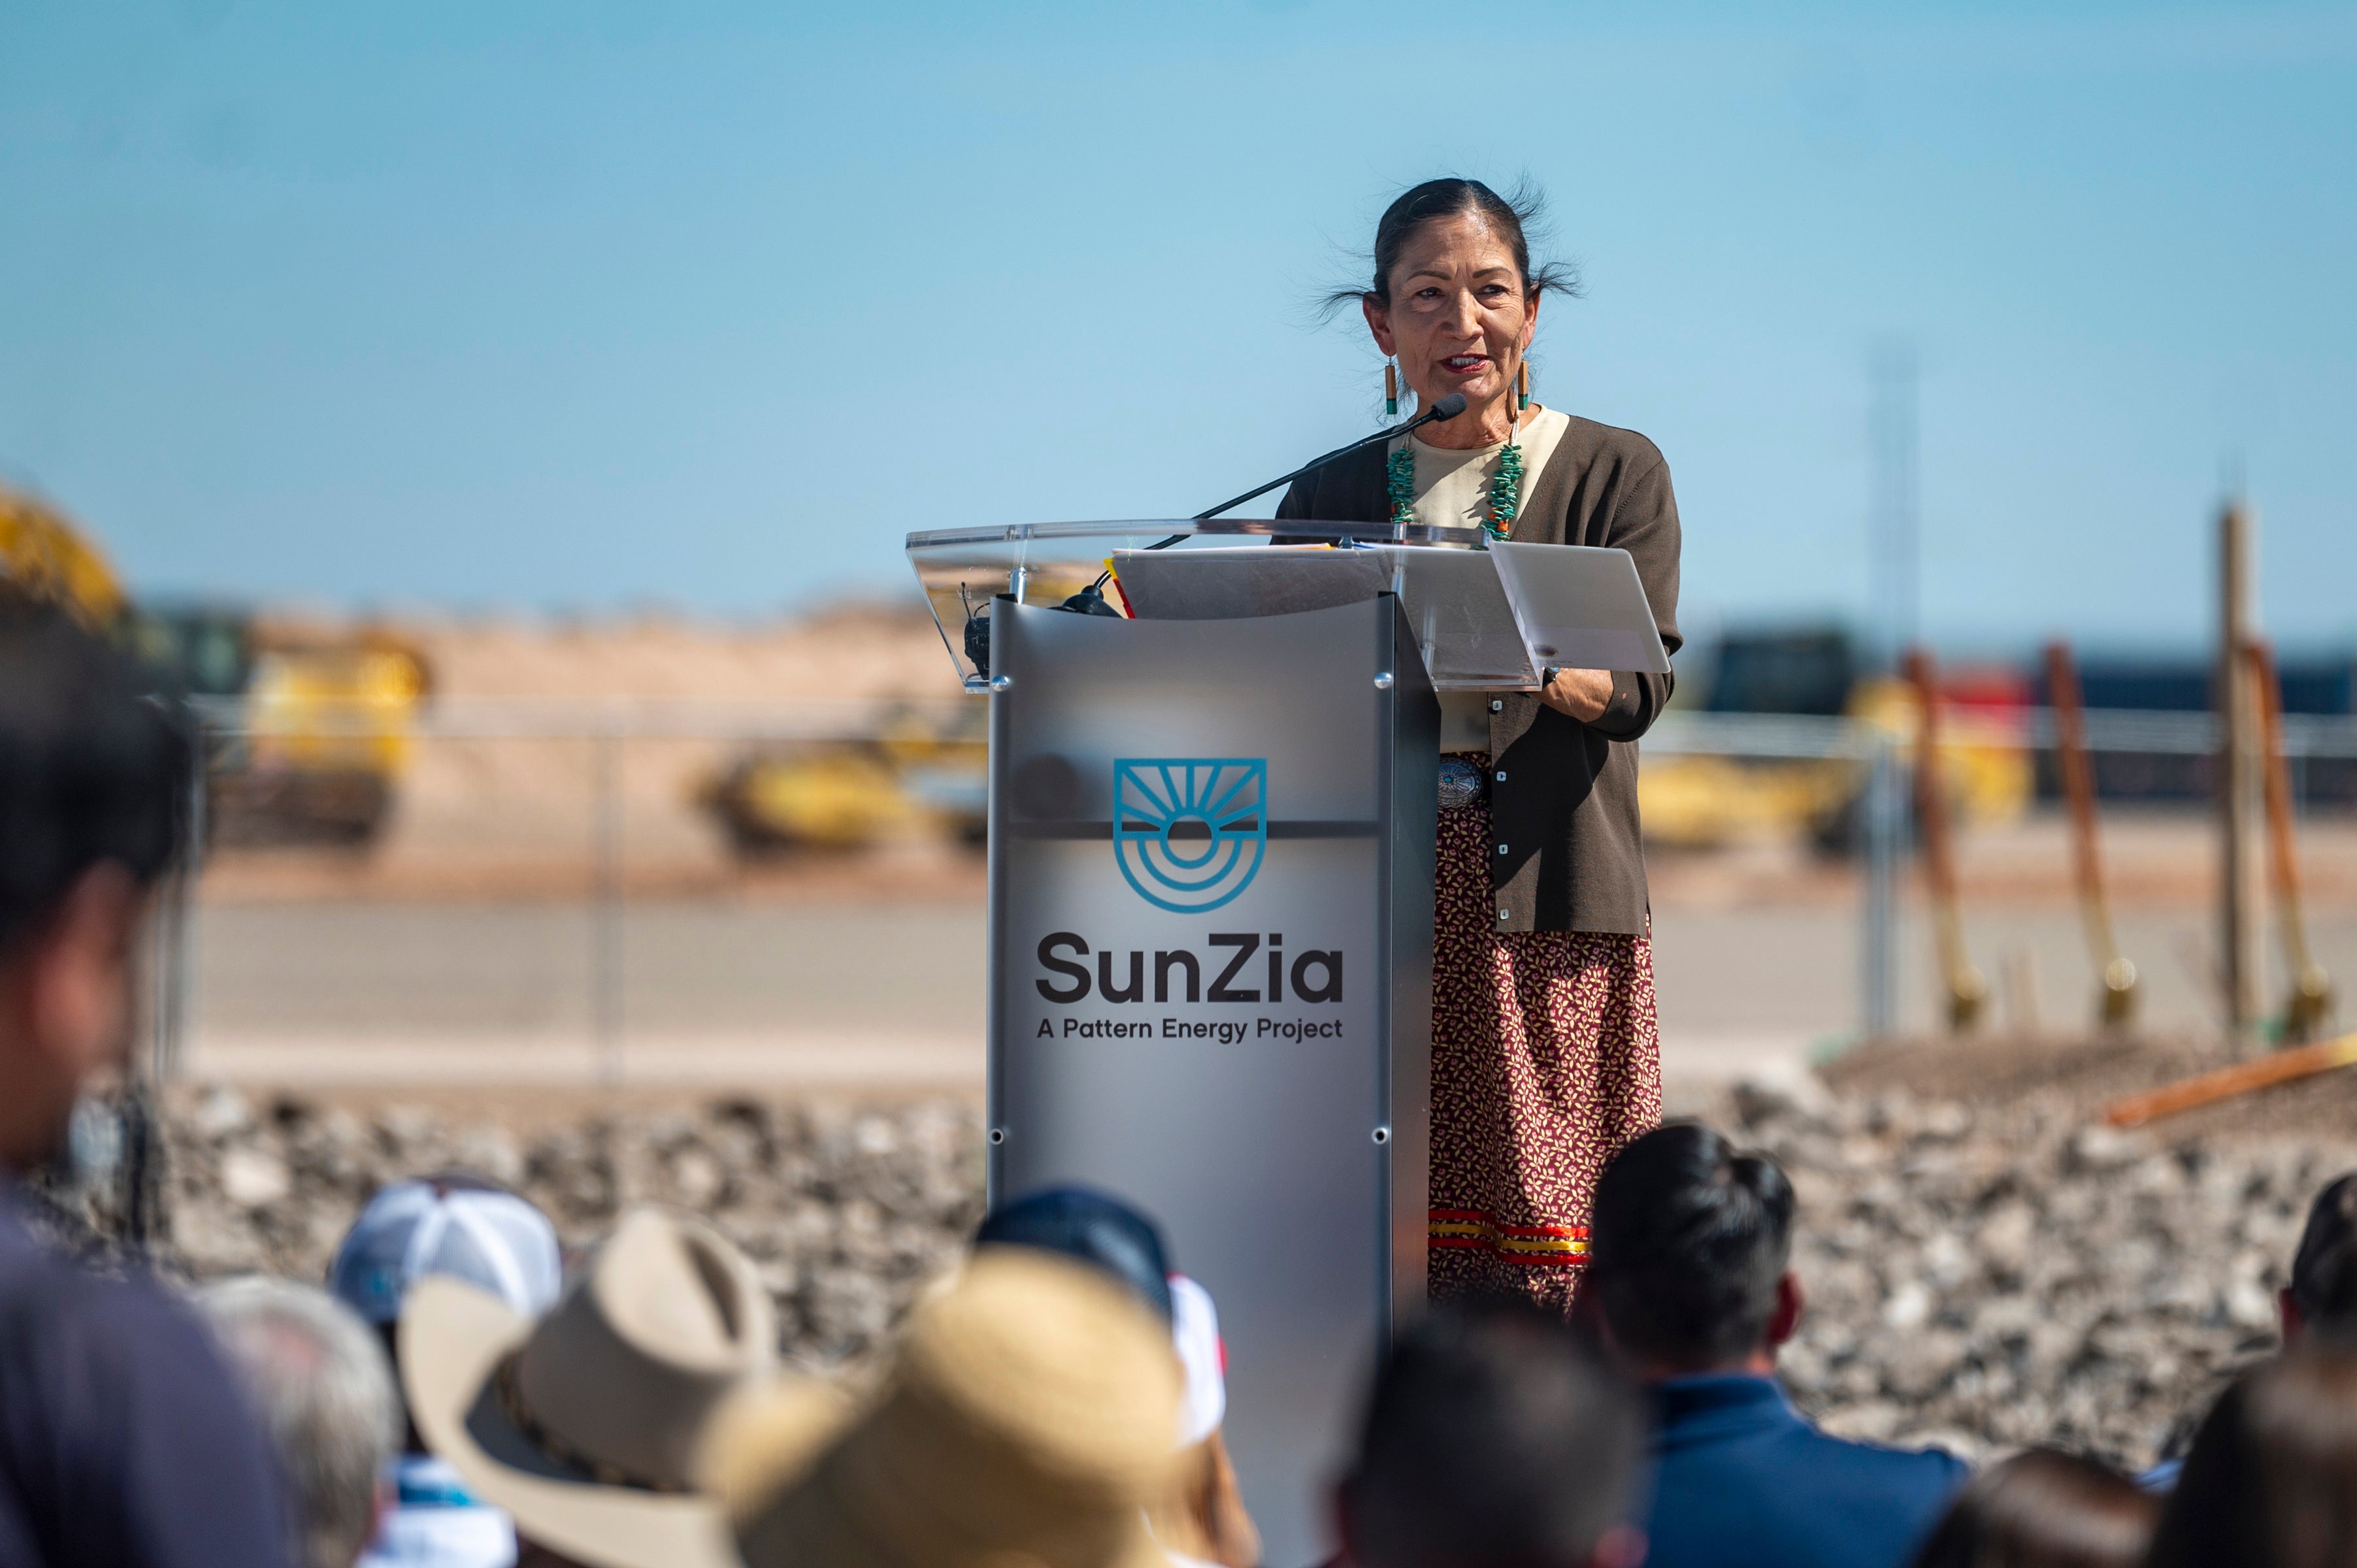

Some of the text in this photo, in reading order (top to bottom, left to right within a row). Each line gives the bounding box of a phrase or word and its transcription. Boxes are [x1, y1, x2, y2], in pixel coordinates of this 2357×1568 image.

[1035, 932, 1343, 1004] SunZia
[1037, 1018, 1343, 1045] A Pattern Energy Project
